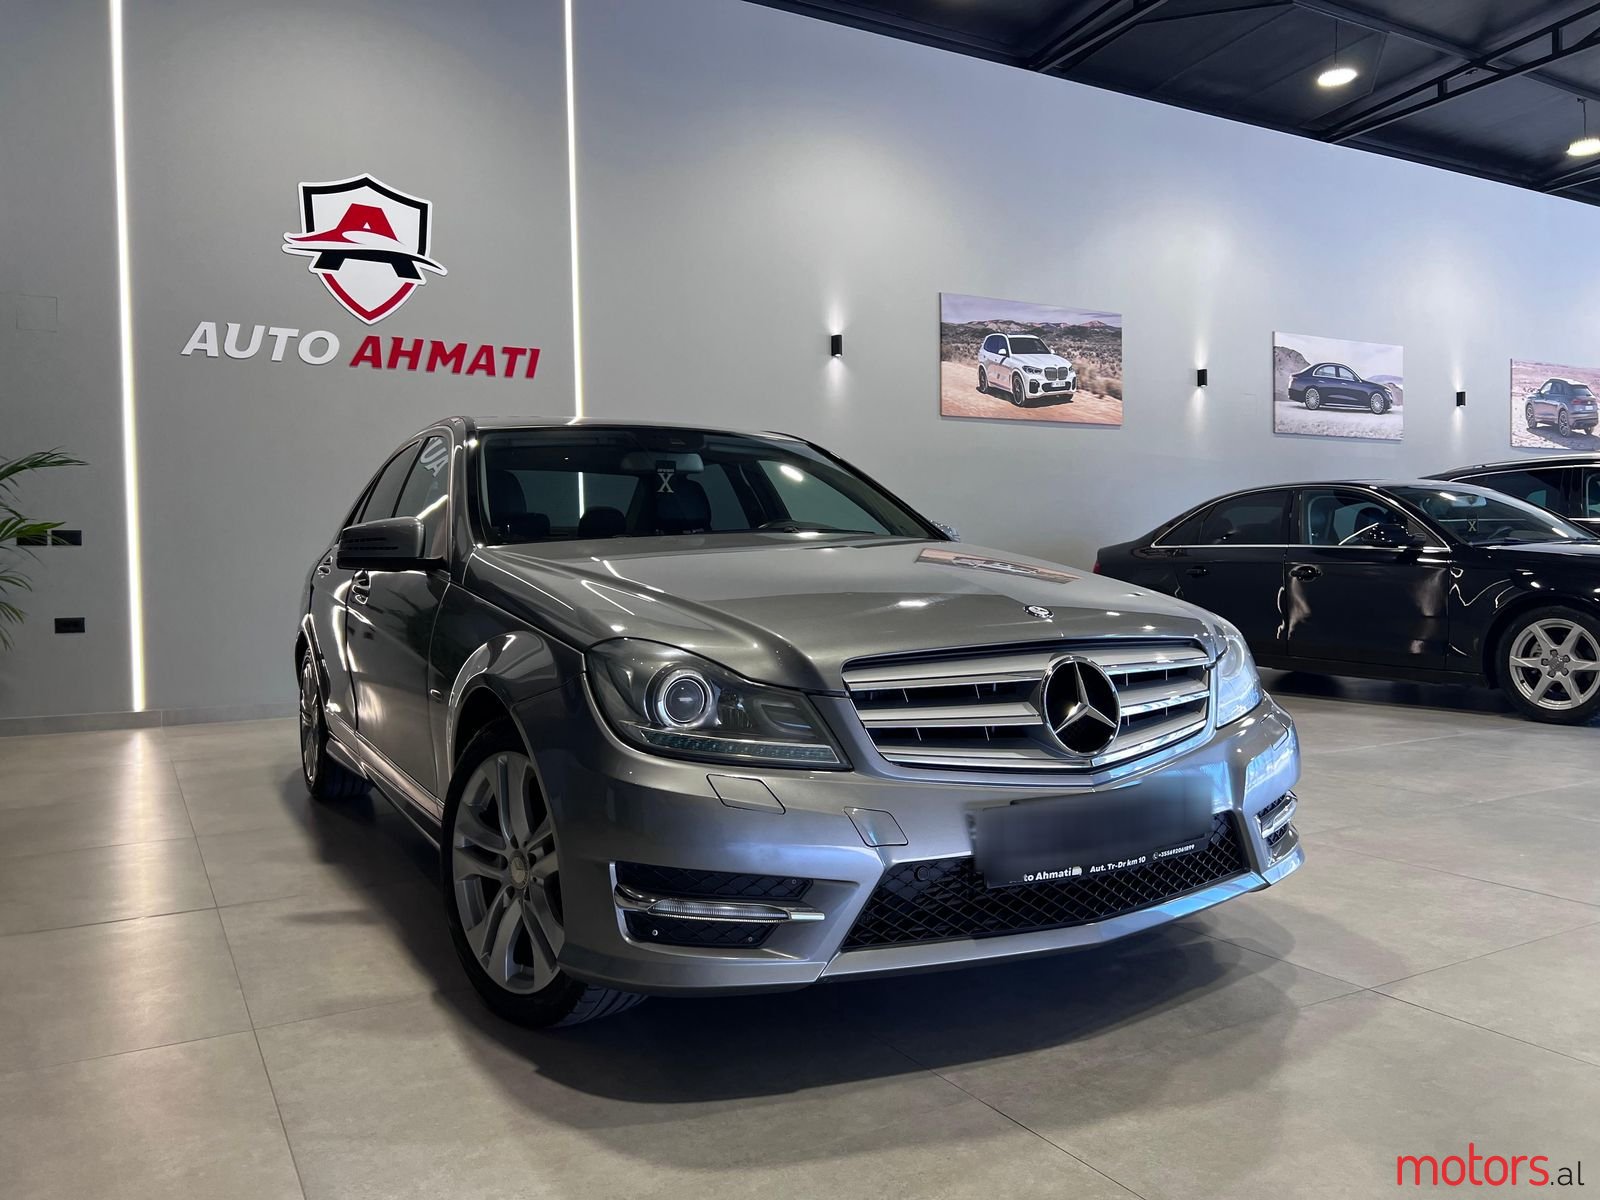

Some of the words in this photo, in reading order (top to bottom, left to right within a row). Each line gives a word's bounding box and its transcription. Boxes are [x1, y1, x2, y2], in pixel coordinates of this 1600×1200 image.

[181, 320, 340, 365] AUTO
[349, 335, 541, 379] AHMATI
[1035, 867, 1071, 881] Ahmati
[1126, 858, 1138, 867] km
[1138, 856, 1146, 864] 10
